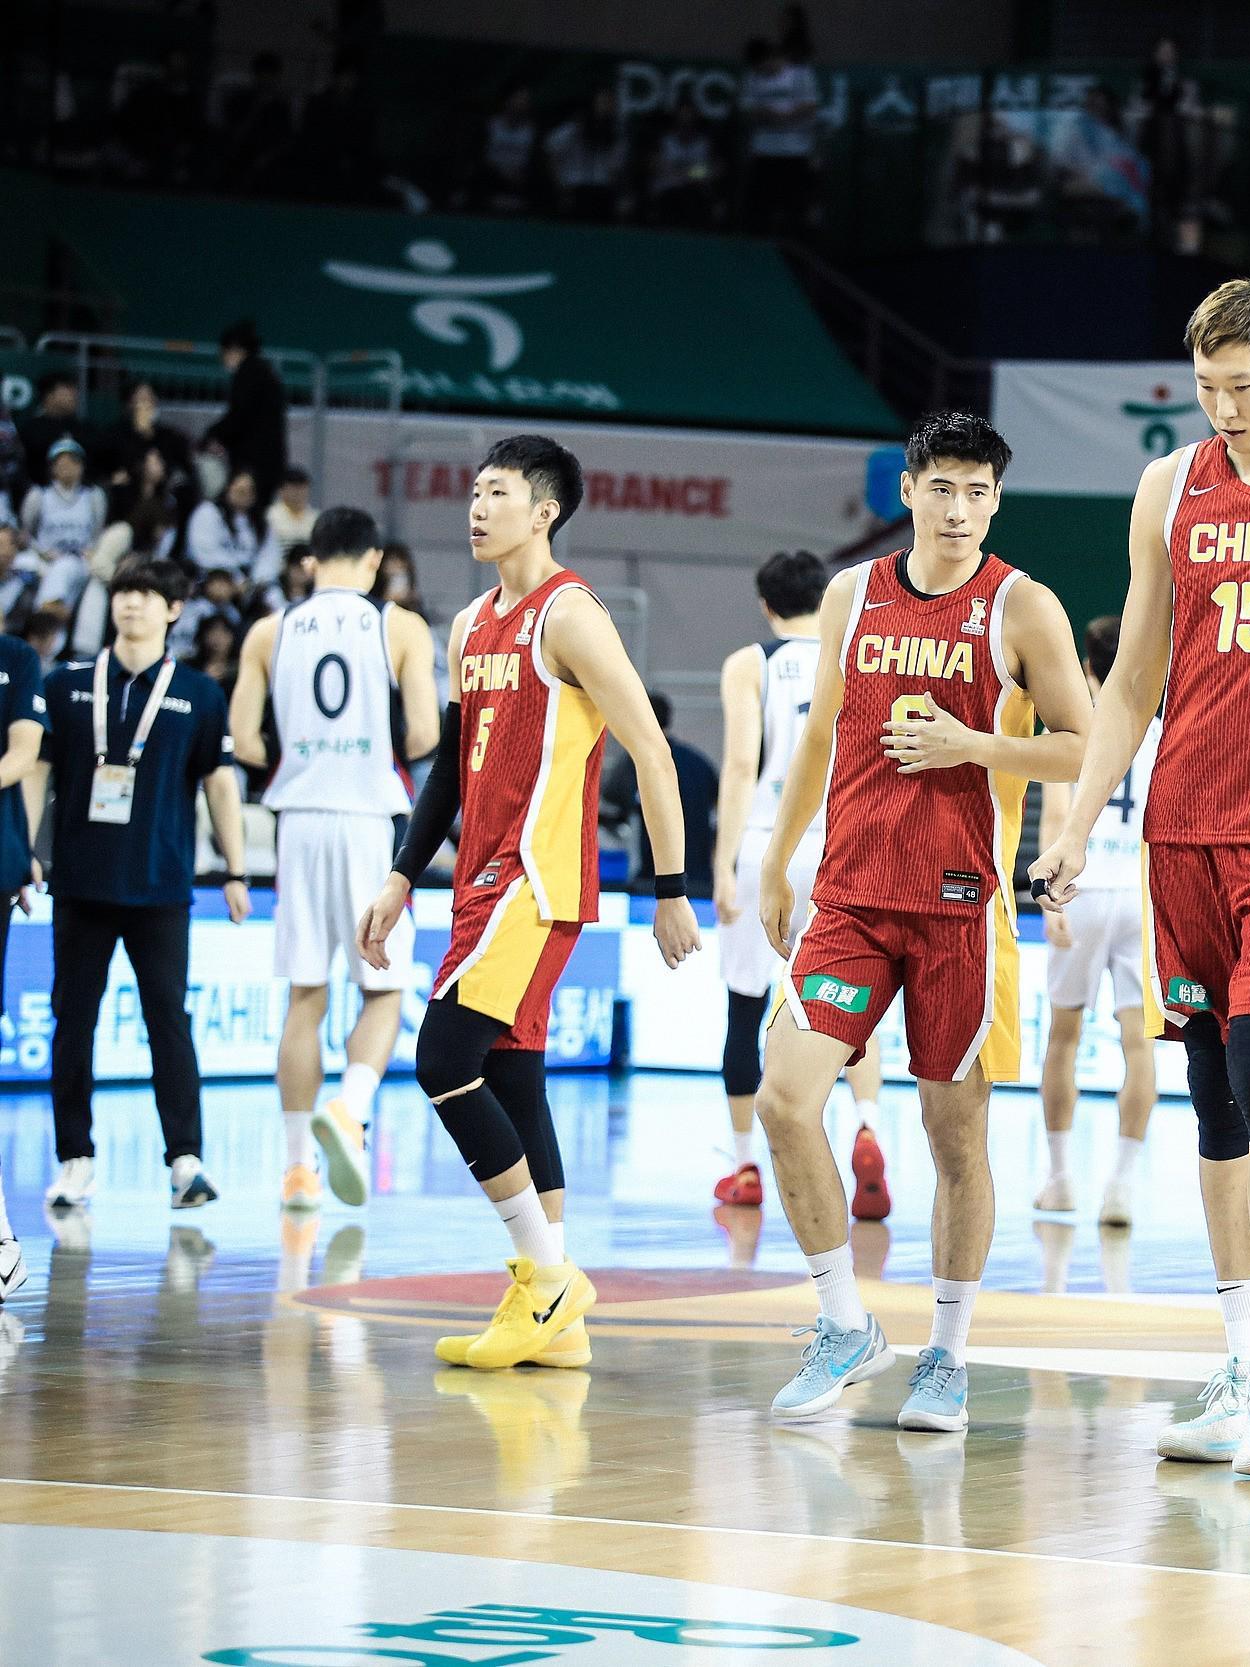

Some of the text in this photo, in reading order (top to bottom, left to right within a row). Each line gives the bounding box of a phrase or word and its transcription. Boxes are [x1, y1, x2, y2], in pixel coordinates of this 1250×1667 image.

[460, 653, 521, 693] CHINA
[857, 634, 974, 683] CHINA
[313, 653, 350, 719] 0
[471, 707, 495, 772] 5
[965, 890, 976, 898] 48
